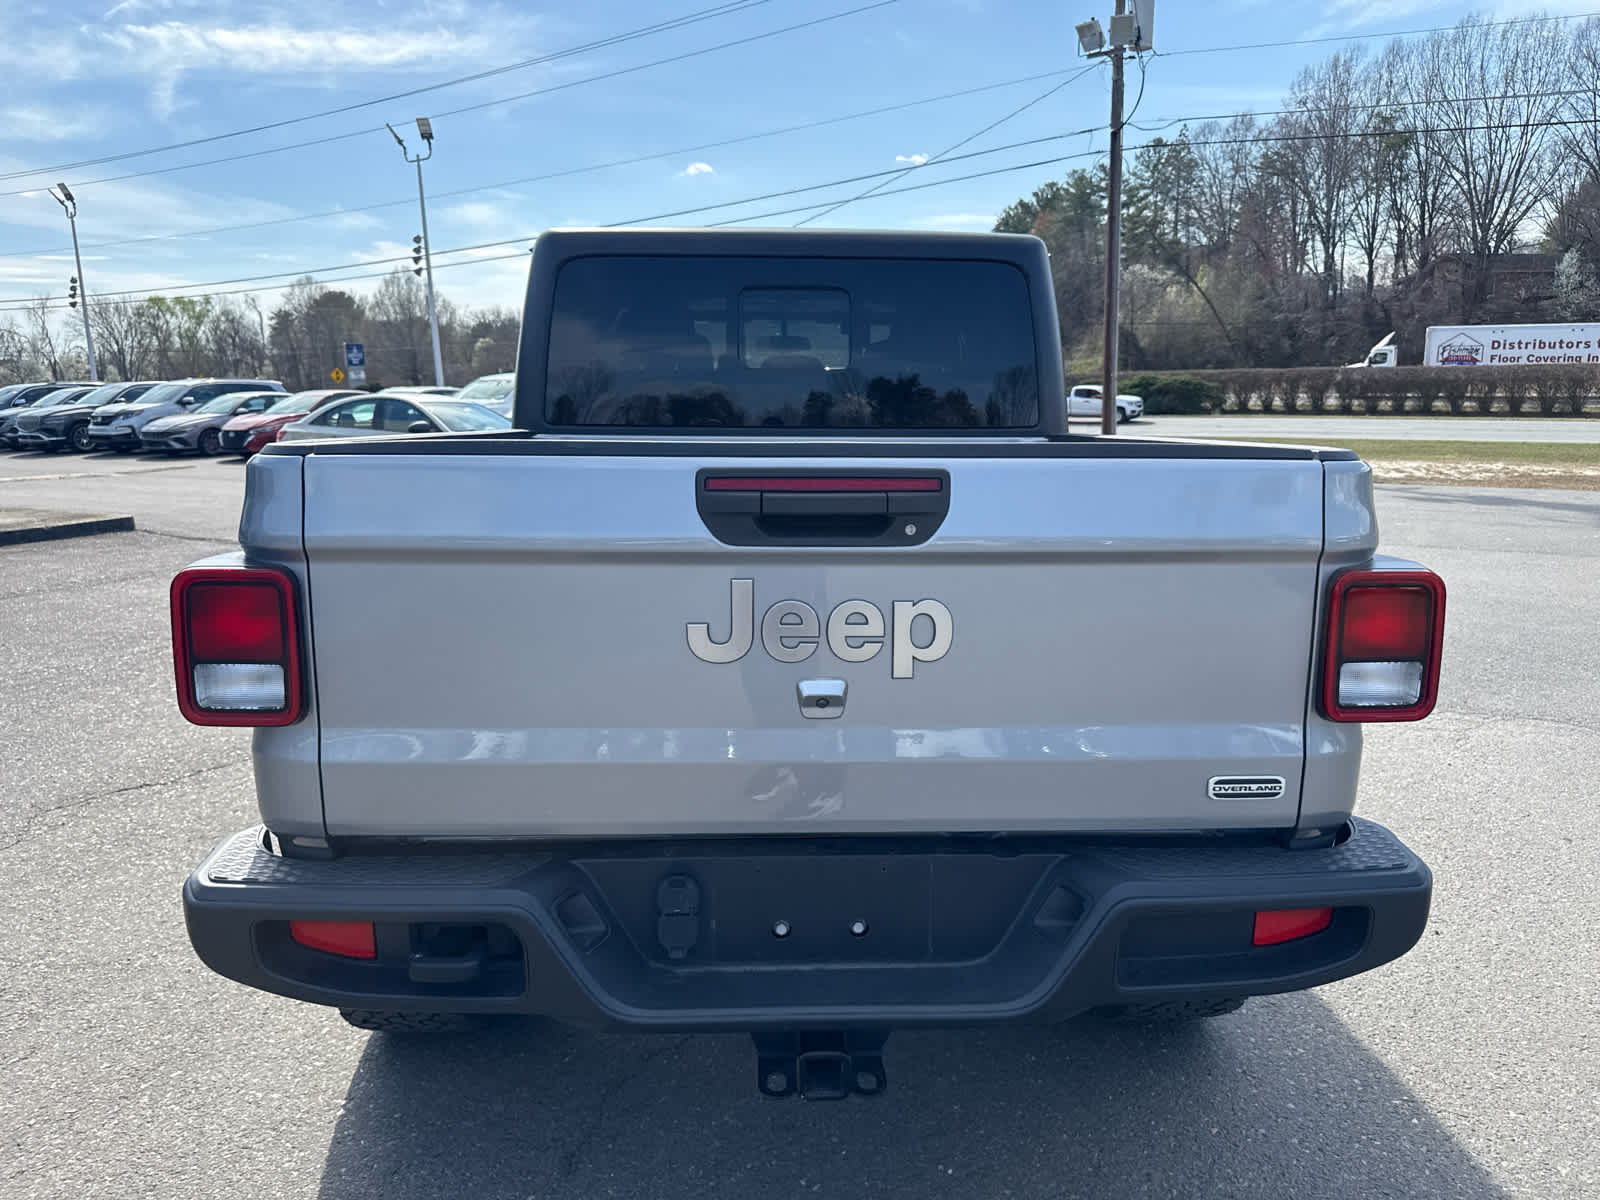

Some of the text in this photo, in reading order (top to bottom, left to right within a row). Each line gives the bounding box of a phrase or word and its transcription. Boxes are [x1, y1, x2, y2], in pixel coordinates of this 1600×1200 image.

[1491, 339, 1591, 350] Distributors
[1490, 354, 1521, 363] Floor
[1526, 353, 1582, 363] Covering
[686, 578, 953, 679] Jeep
